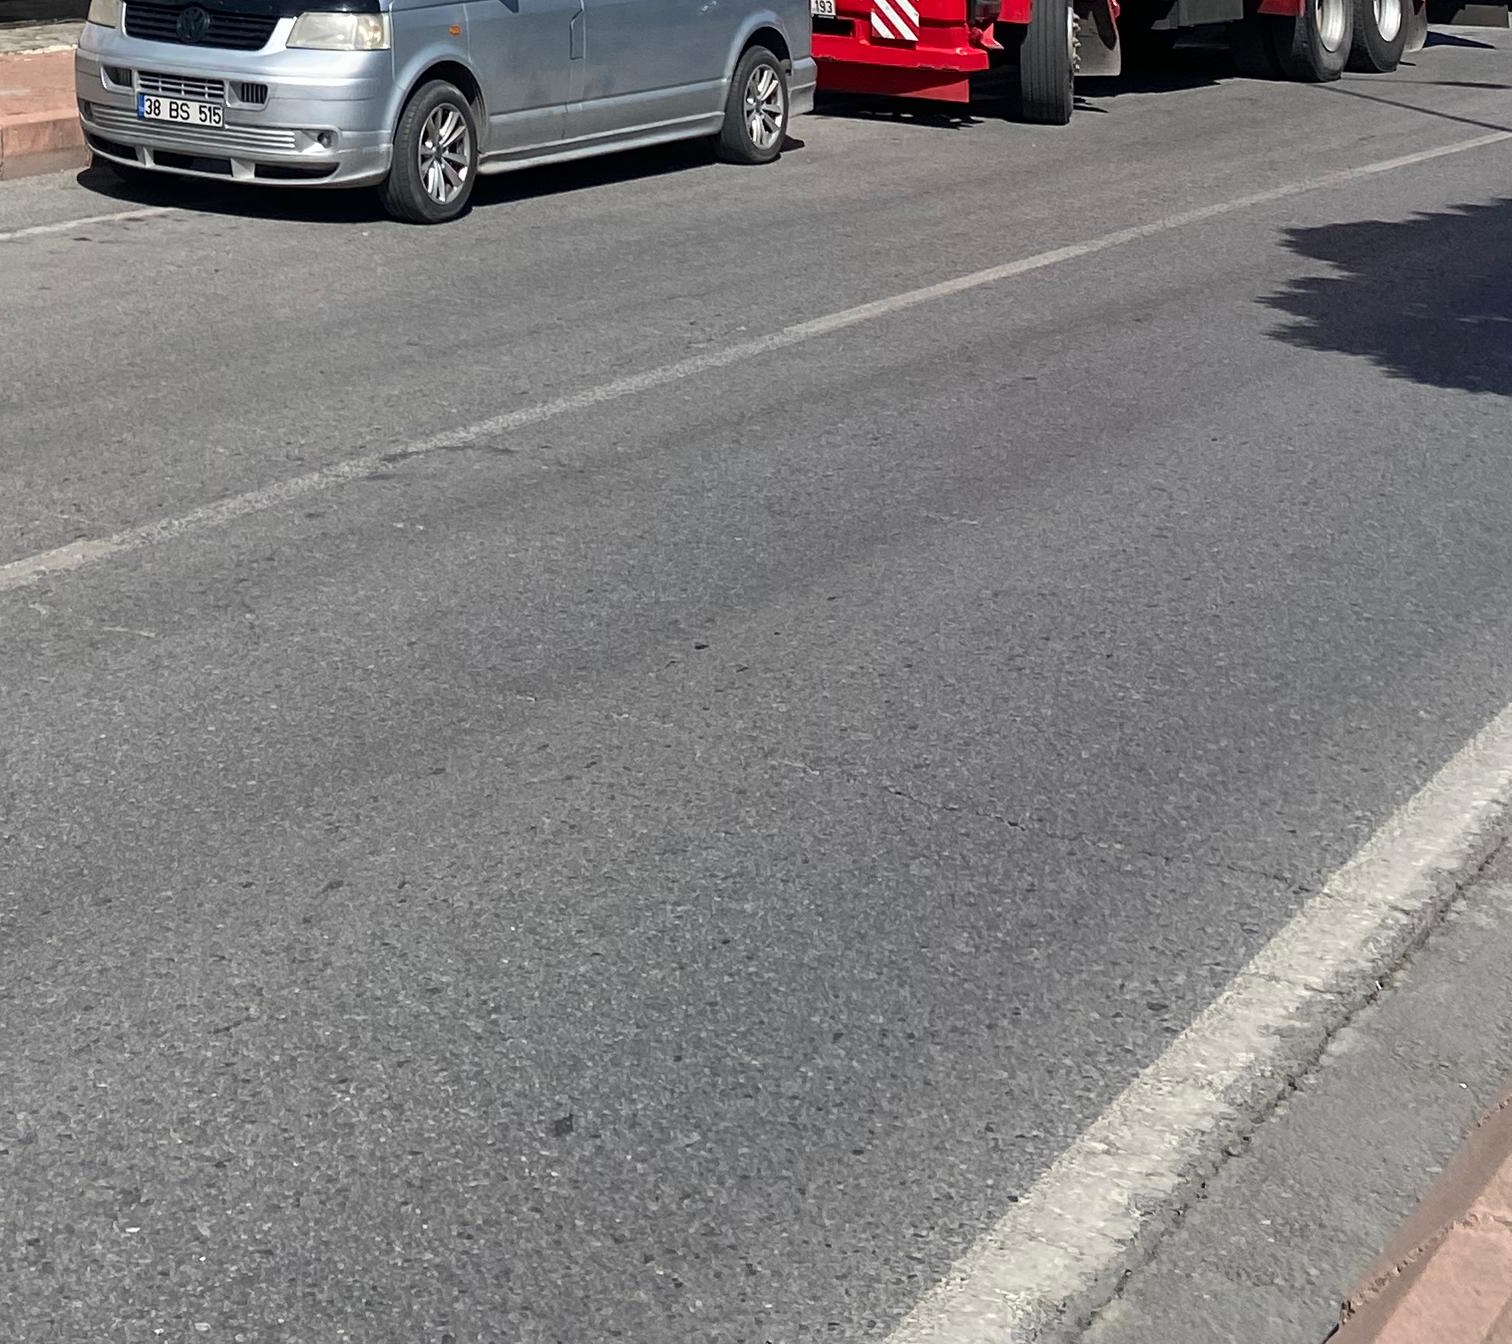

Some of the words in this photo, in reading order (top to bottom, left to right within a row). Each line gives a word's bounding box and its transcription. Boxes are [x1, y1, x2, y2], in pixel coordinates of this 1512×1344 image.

[145, 98, 162, 117] 38
[169, 101, 190, 121] BS
[198, 104, 222, 125] 515
